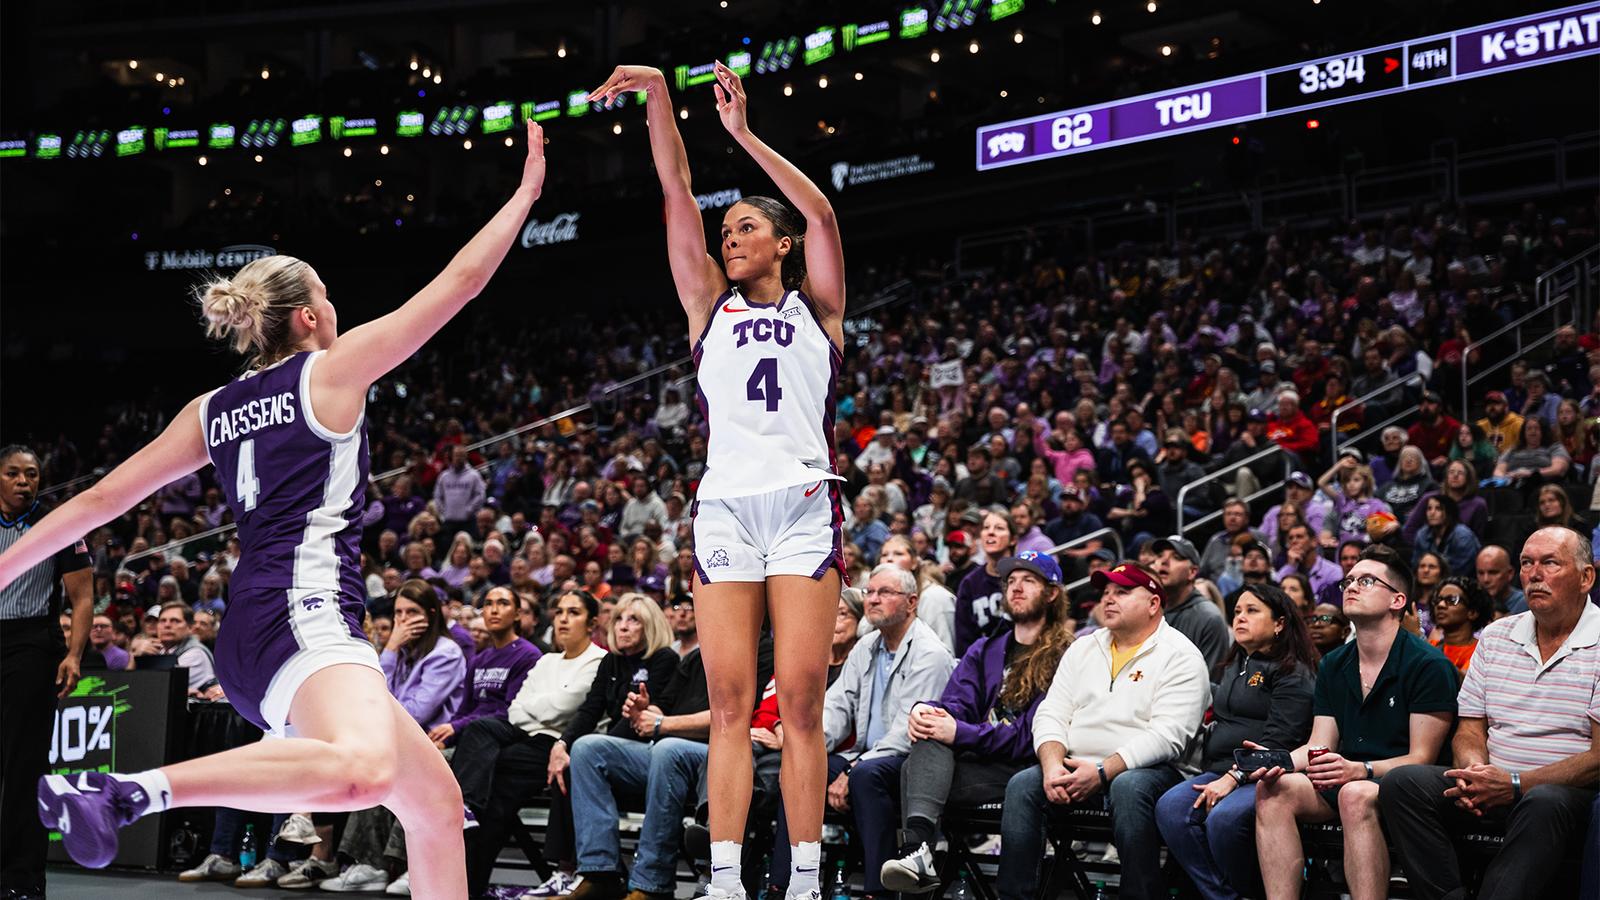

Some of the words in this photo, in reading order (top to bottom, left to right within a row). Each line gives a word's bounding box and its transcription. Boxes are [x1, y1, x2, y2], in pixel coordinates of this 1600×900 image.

[1299, 53, 1366, 94] 3:34
[1412, 47, 1448, 71] 4TH
[1155, 91, 1211, 126] TCU
[986, 131, 1026, 158] TCU
[1051, 112, 1093, 150] 62
[695, 188, 742, 210] OYOTA
[733, 318, 796, 348] TCU
[746, 358, 782, 412] 4
[210, 392, 295, 447] CAESSENS
[237, 439, 260, 512] 4
[972, 592, 1012, 628] TC
